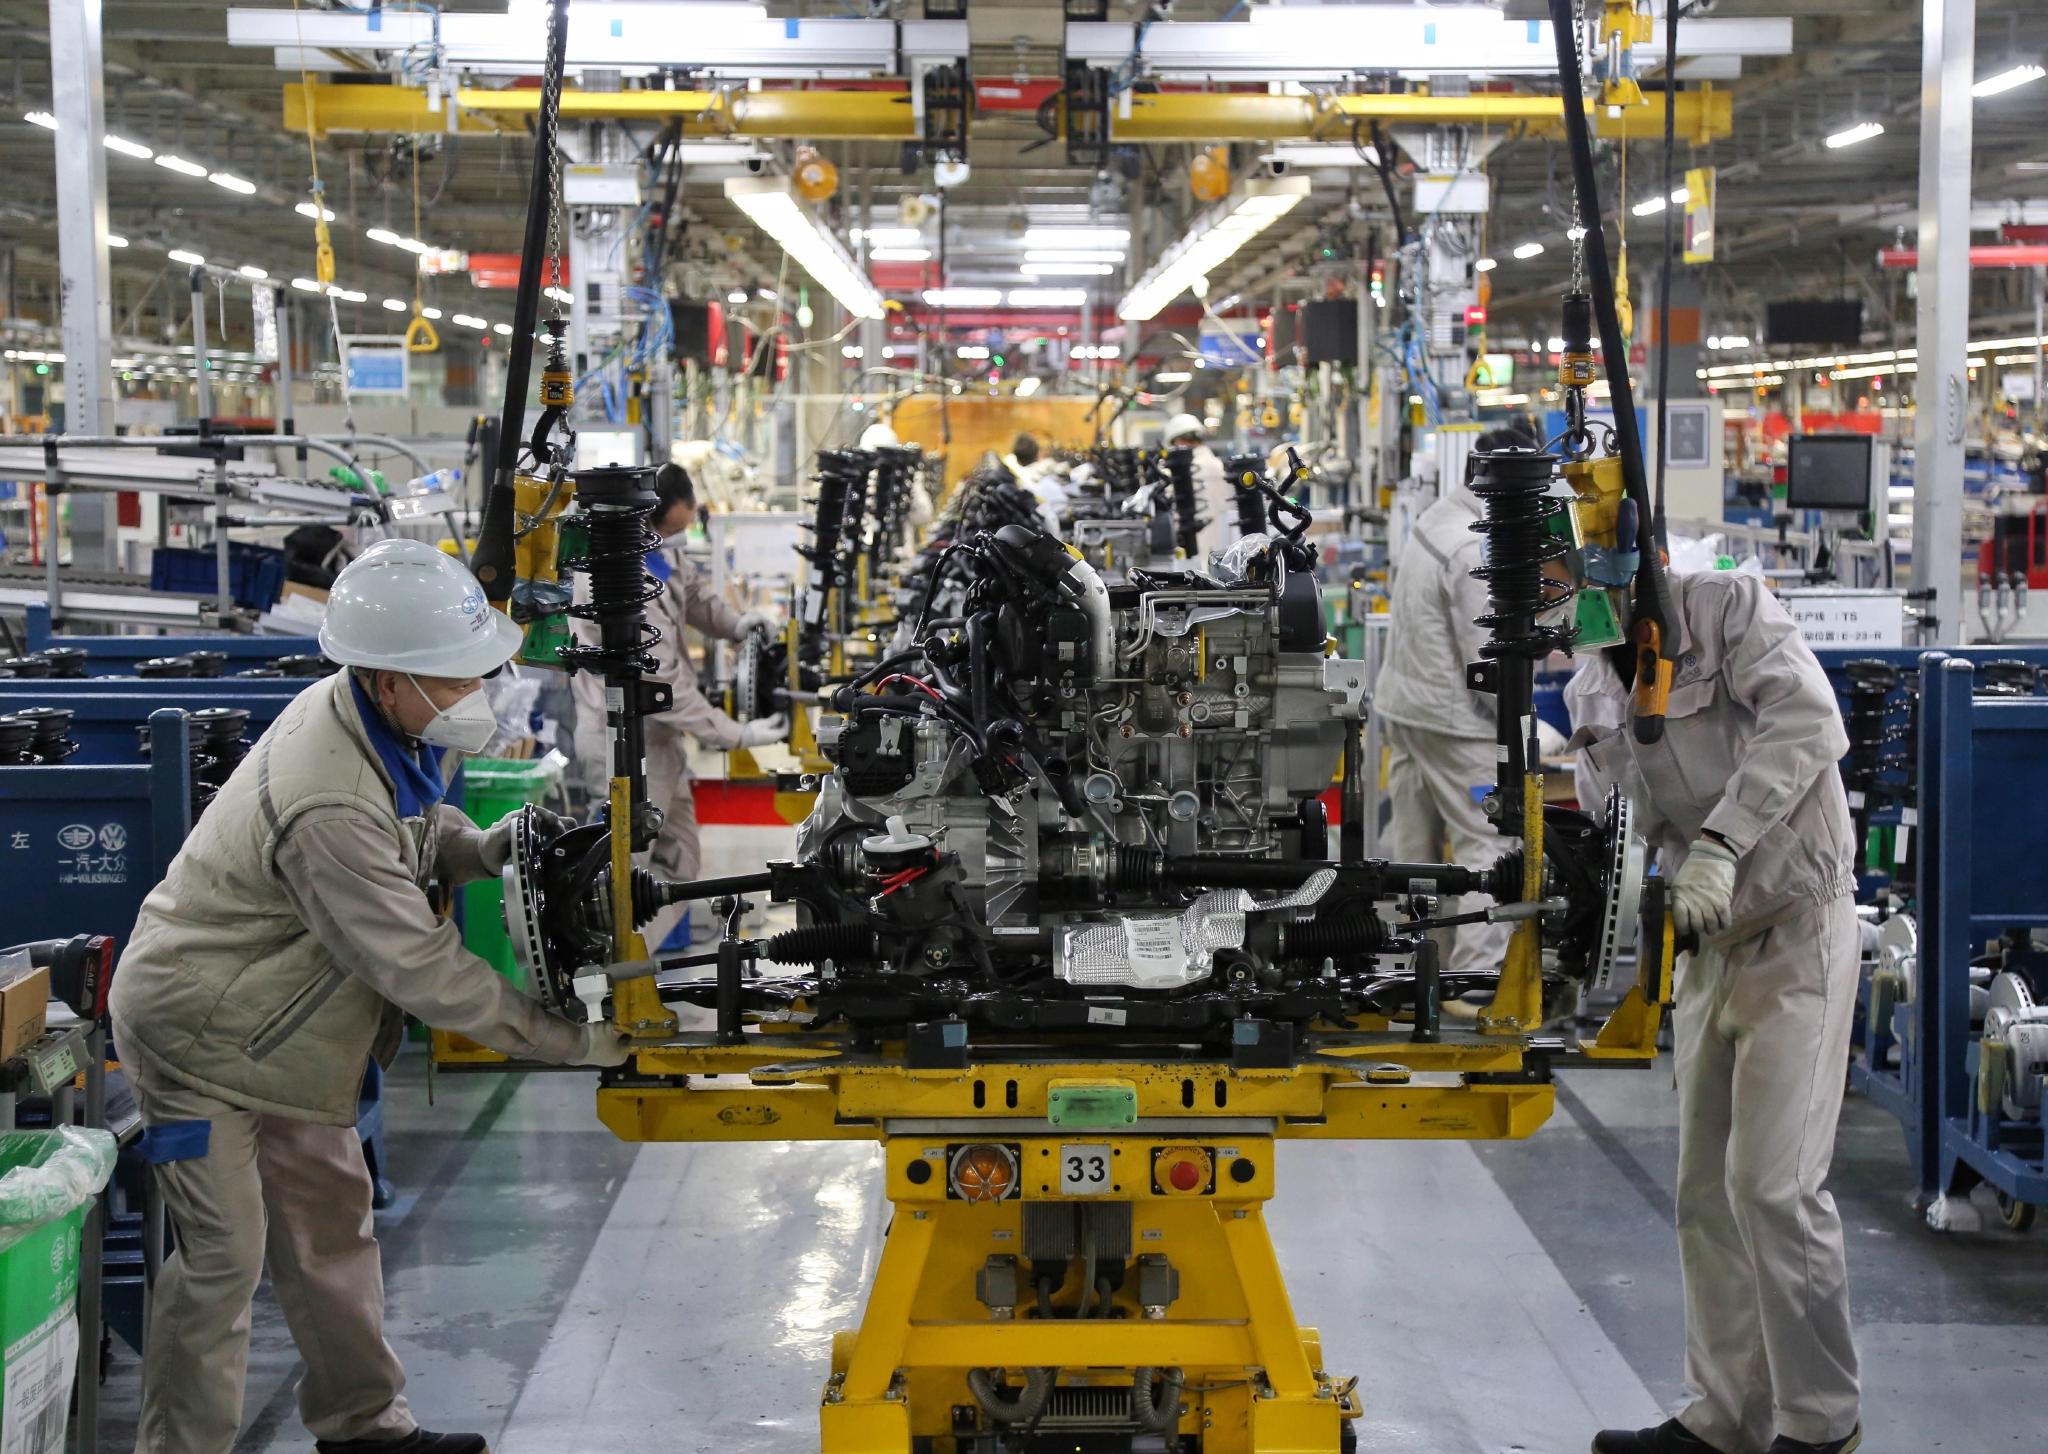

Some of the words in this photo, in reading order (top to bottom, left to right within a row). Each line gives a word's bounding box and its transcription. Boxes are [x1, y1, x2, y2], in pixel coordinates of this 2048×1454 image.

[1794, 611, 1825, 622] 生产线
[11, 831, 31, 849] 左
[58, 853, 128, 872] 一汽-大众
[1163, 1145, 1201, 1160] EMERGENCY
[1199, 1155, 1210, 1173] STOP
[1066, 1156, 1105, 1183] 33
